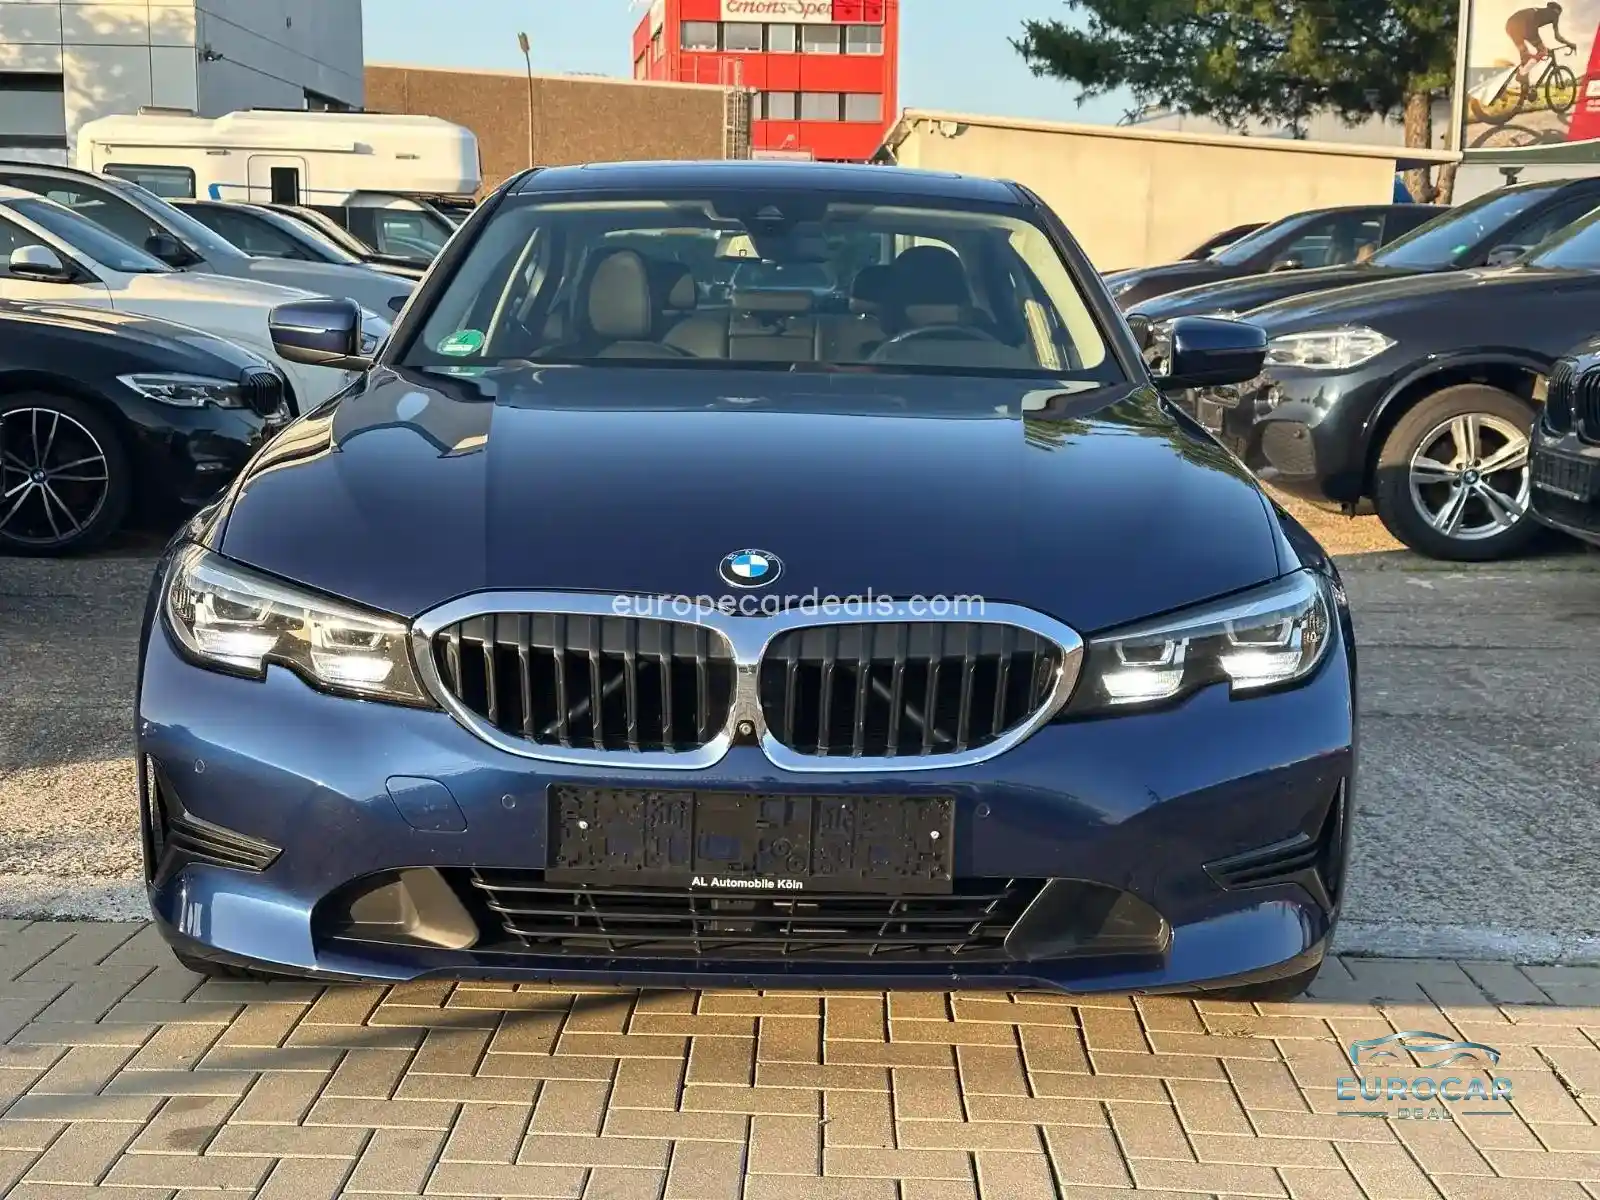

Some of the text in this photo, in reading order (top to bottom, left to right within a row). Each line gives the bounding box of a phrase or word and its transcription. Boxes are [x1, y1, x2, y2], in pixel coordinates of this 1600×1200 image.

[692, 877, 803, 889] AL Automobile Köln
